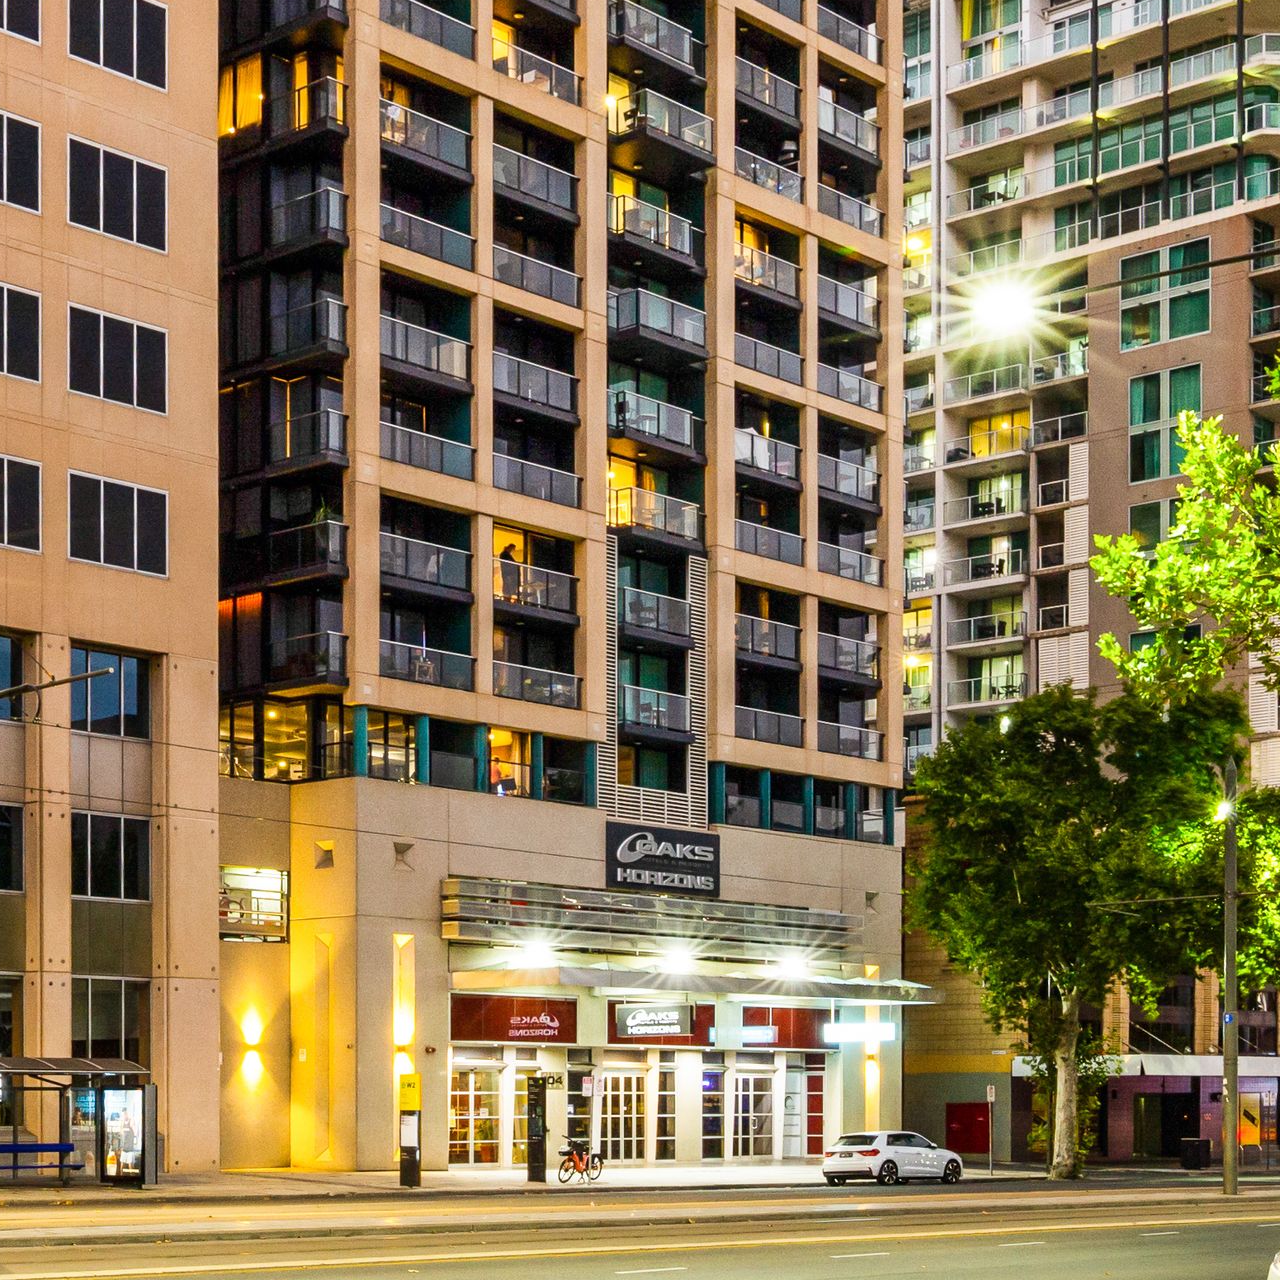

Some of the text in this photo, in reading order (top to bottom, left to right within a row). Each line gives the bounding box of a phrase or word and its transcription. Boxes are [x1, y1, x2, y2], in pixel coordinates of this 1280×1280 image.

[617, 832, 714, 862] OAKS
[617, 868, 714, 890] HORIZONS
[627, 1025, 681, 1035] HORIZONS
[547, 1075, 564, 1085] 04
